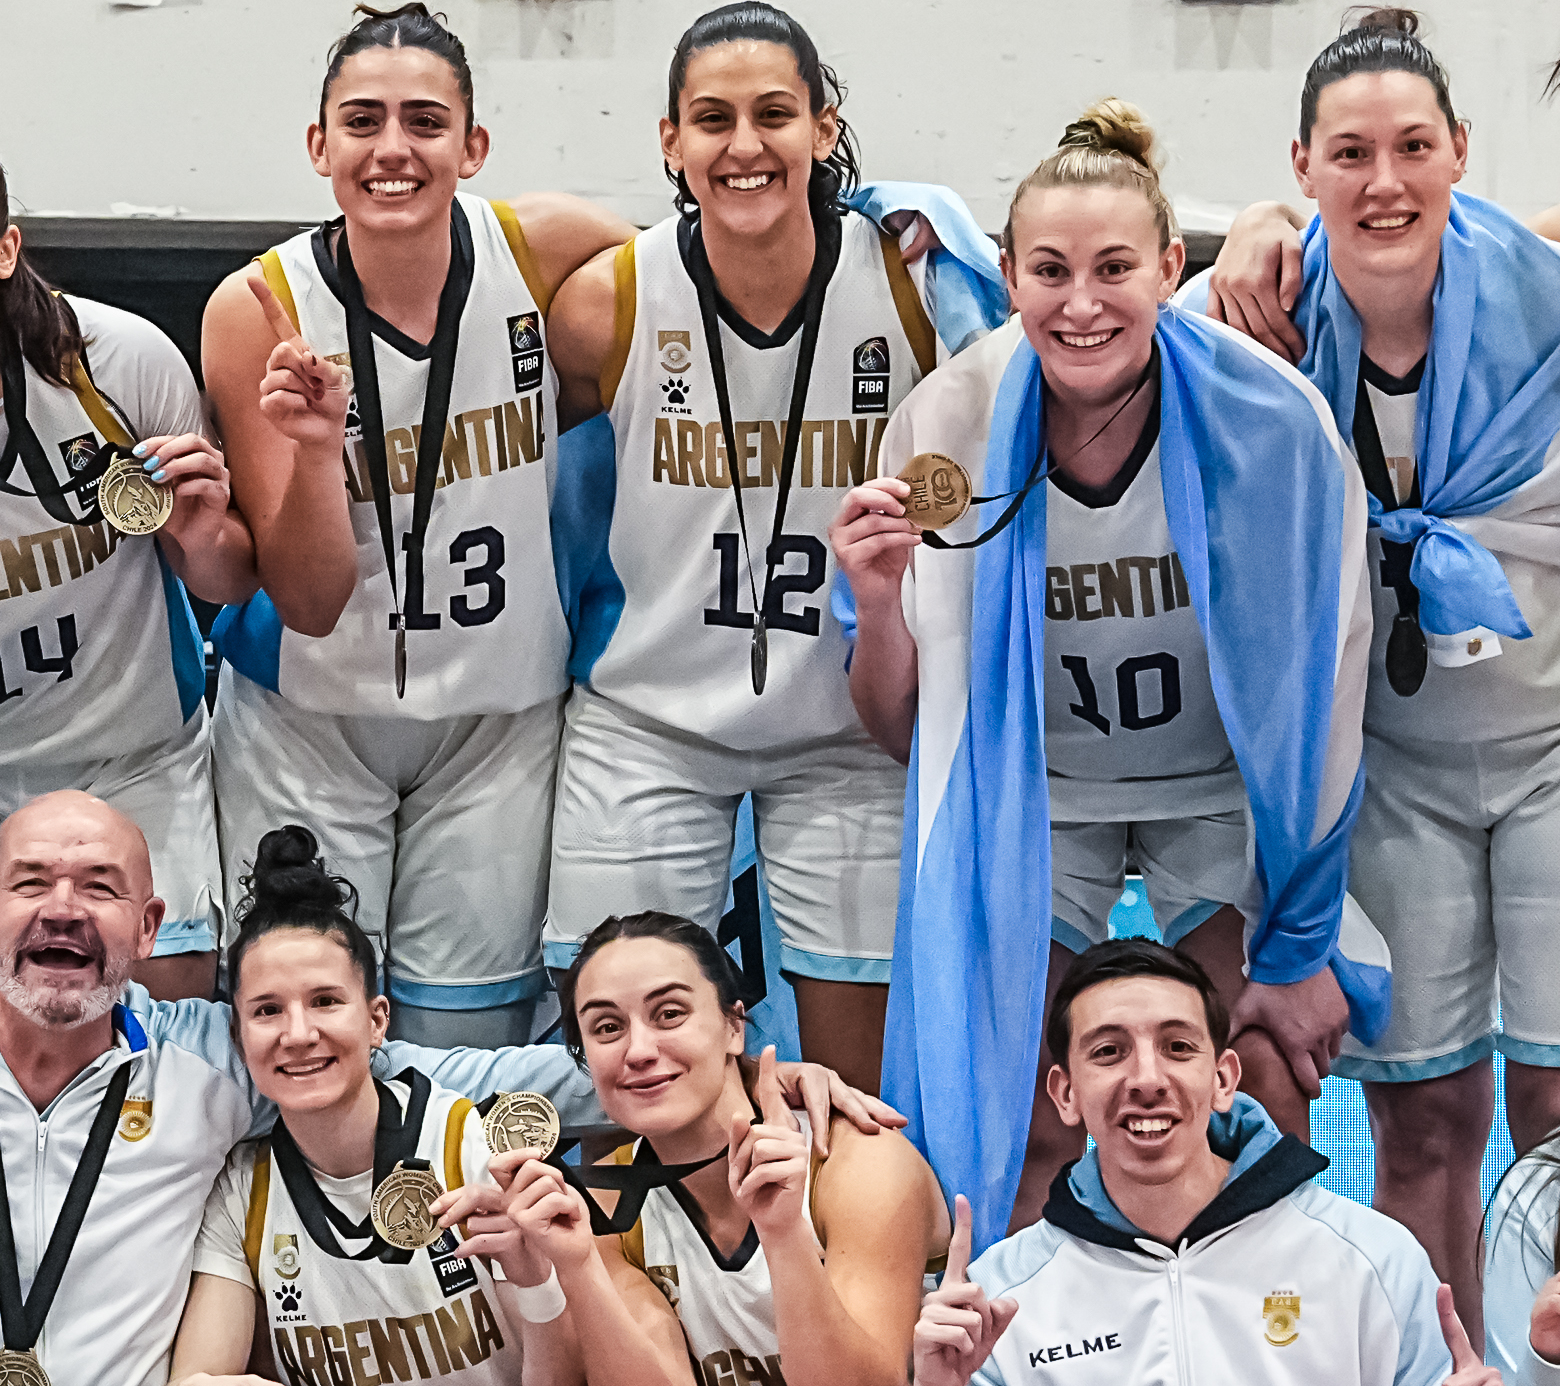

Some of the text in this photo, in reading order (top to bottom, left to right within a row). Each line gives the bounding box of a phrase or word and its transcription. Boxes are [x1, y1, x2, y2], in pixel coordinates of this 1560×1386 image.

[518, 356, 540, 373] FIBA
[858, 380, 884, 394] FIBA
[660, 406, 693, 415] KELME
[389, 525, 506, 630] 13
[703, 532, 828, 637] 12
[1060, 652, 1182, 738] 10
[439, 1258, 467, 1277] FIBA
[276, 1314, 305, 1323] KELME
[1028, 1333, 1122, 1369] KELME
